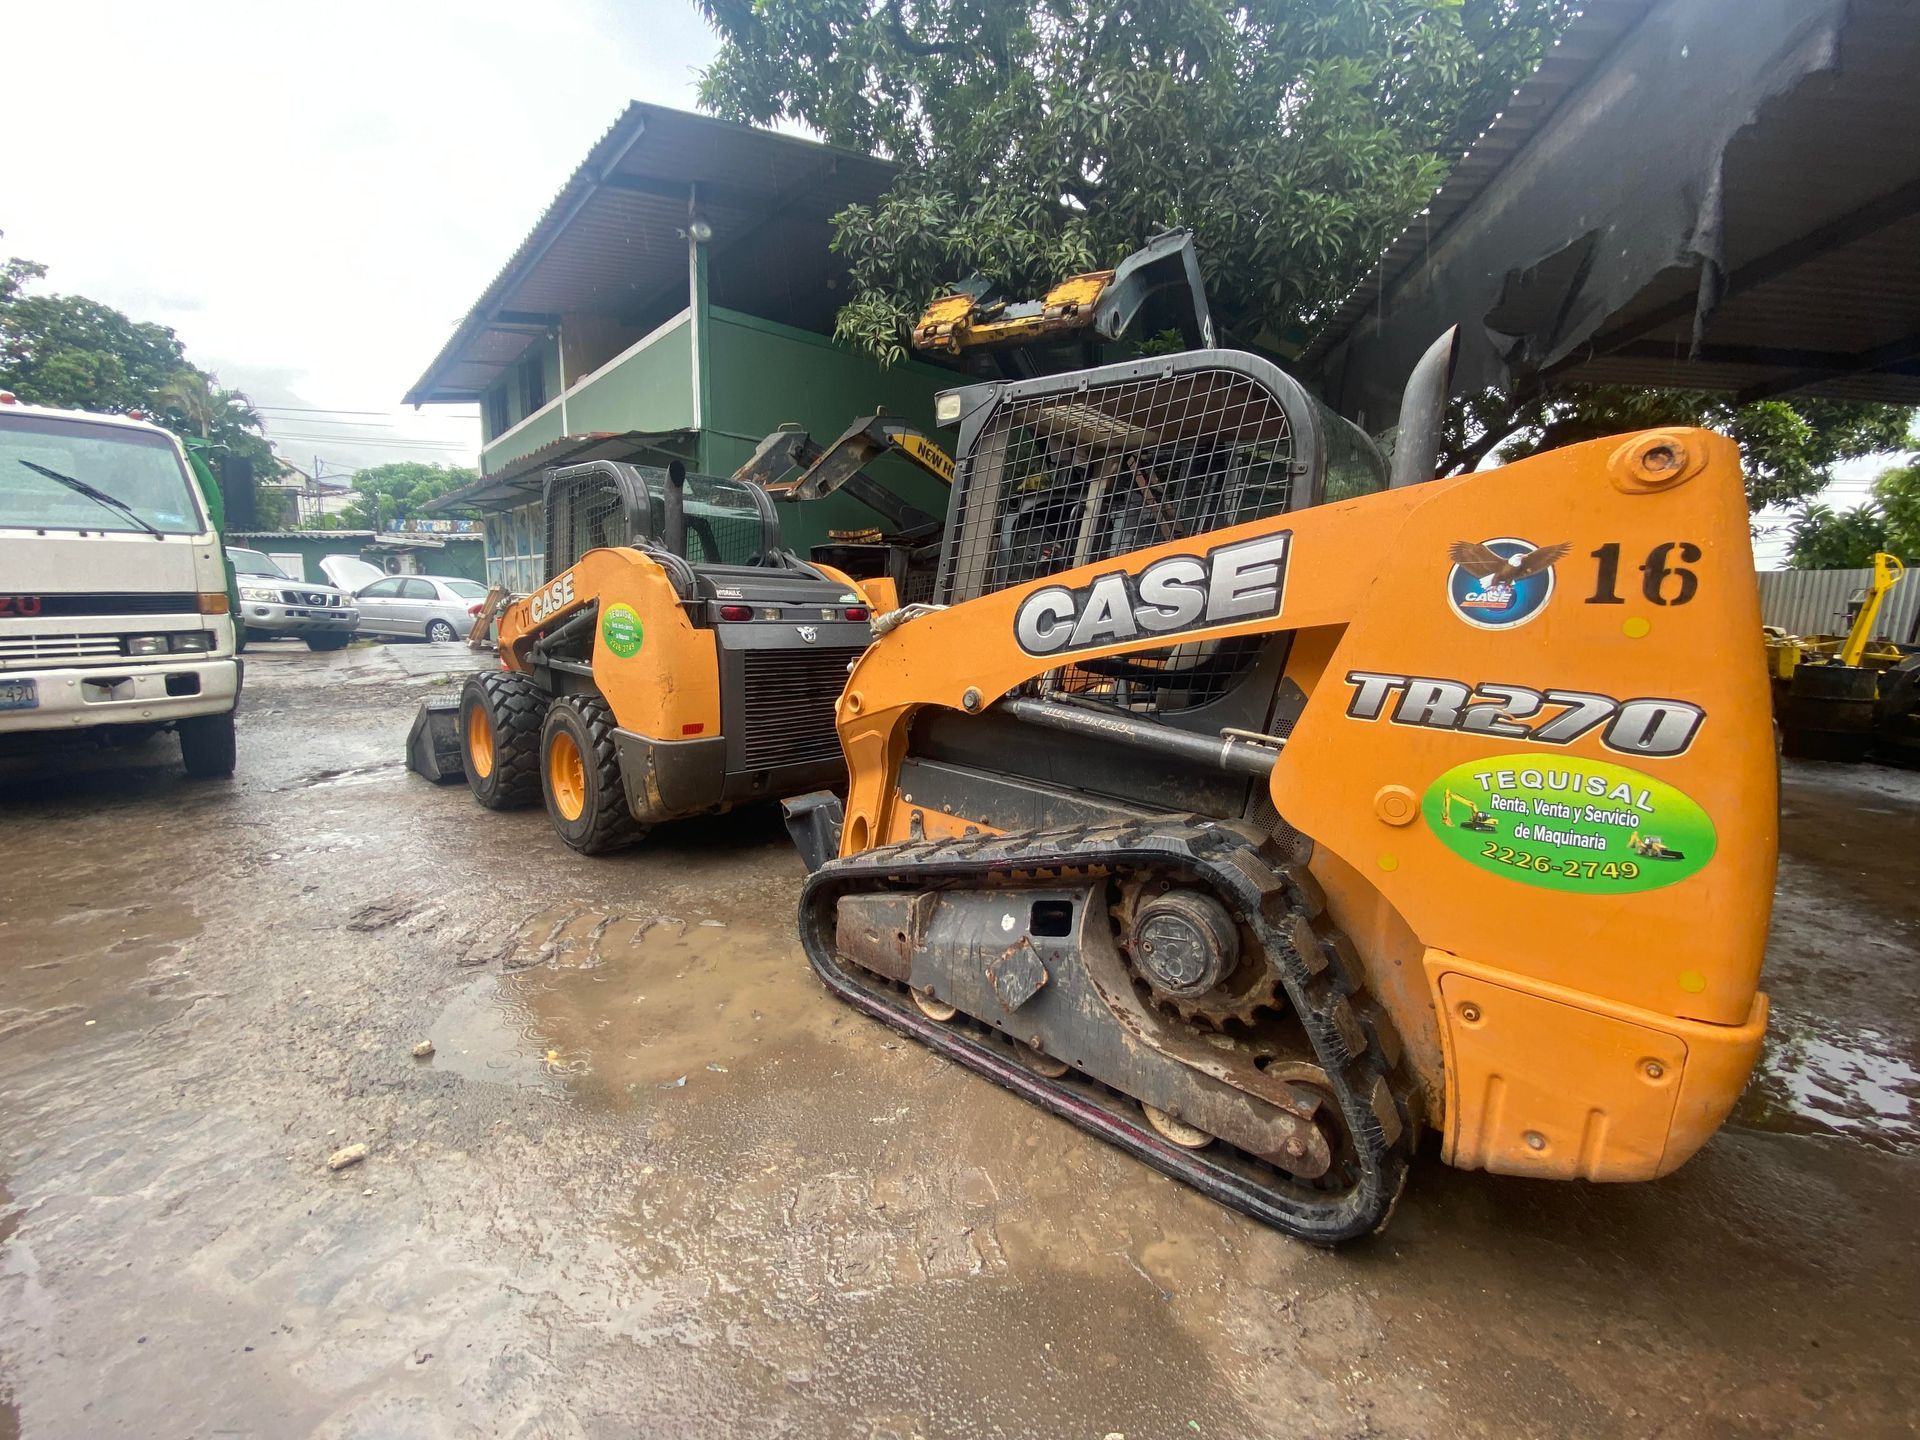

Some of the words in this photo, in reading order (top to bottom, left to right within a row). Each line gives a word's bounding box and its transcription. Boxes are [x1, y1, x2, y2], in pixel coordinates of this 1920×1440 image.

[917, 441, 943, 468] NEW
[1015, 532, 1290, 654] CASE
[1584, 542, 1703, 606] 16
[531, 573, 575, 623] CASE
[1464, 591, 1512, 603] CASE
[1345, 671, 1707, 758] TR270
[1473, 768, 1655, 812] TEQUISAL
[1491, 794, 1530, 816] Renta,
[1533, 799, 1570, 818] Venta
[1573, 807, 1581, 822] y
[1584, 805, 1640, 828] Servicio
[1514, 823, 1530, 839] de
[1533, 826, 1607, 851] Maquinaria
[1480, 841, 1641, 879] 2226-2749
